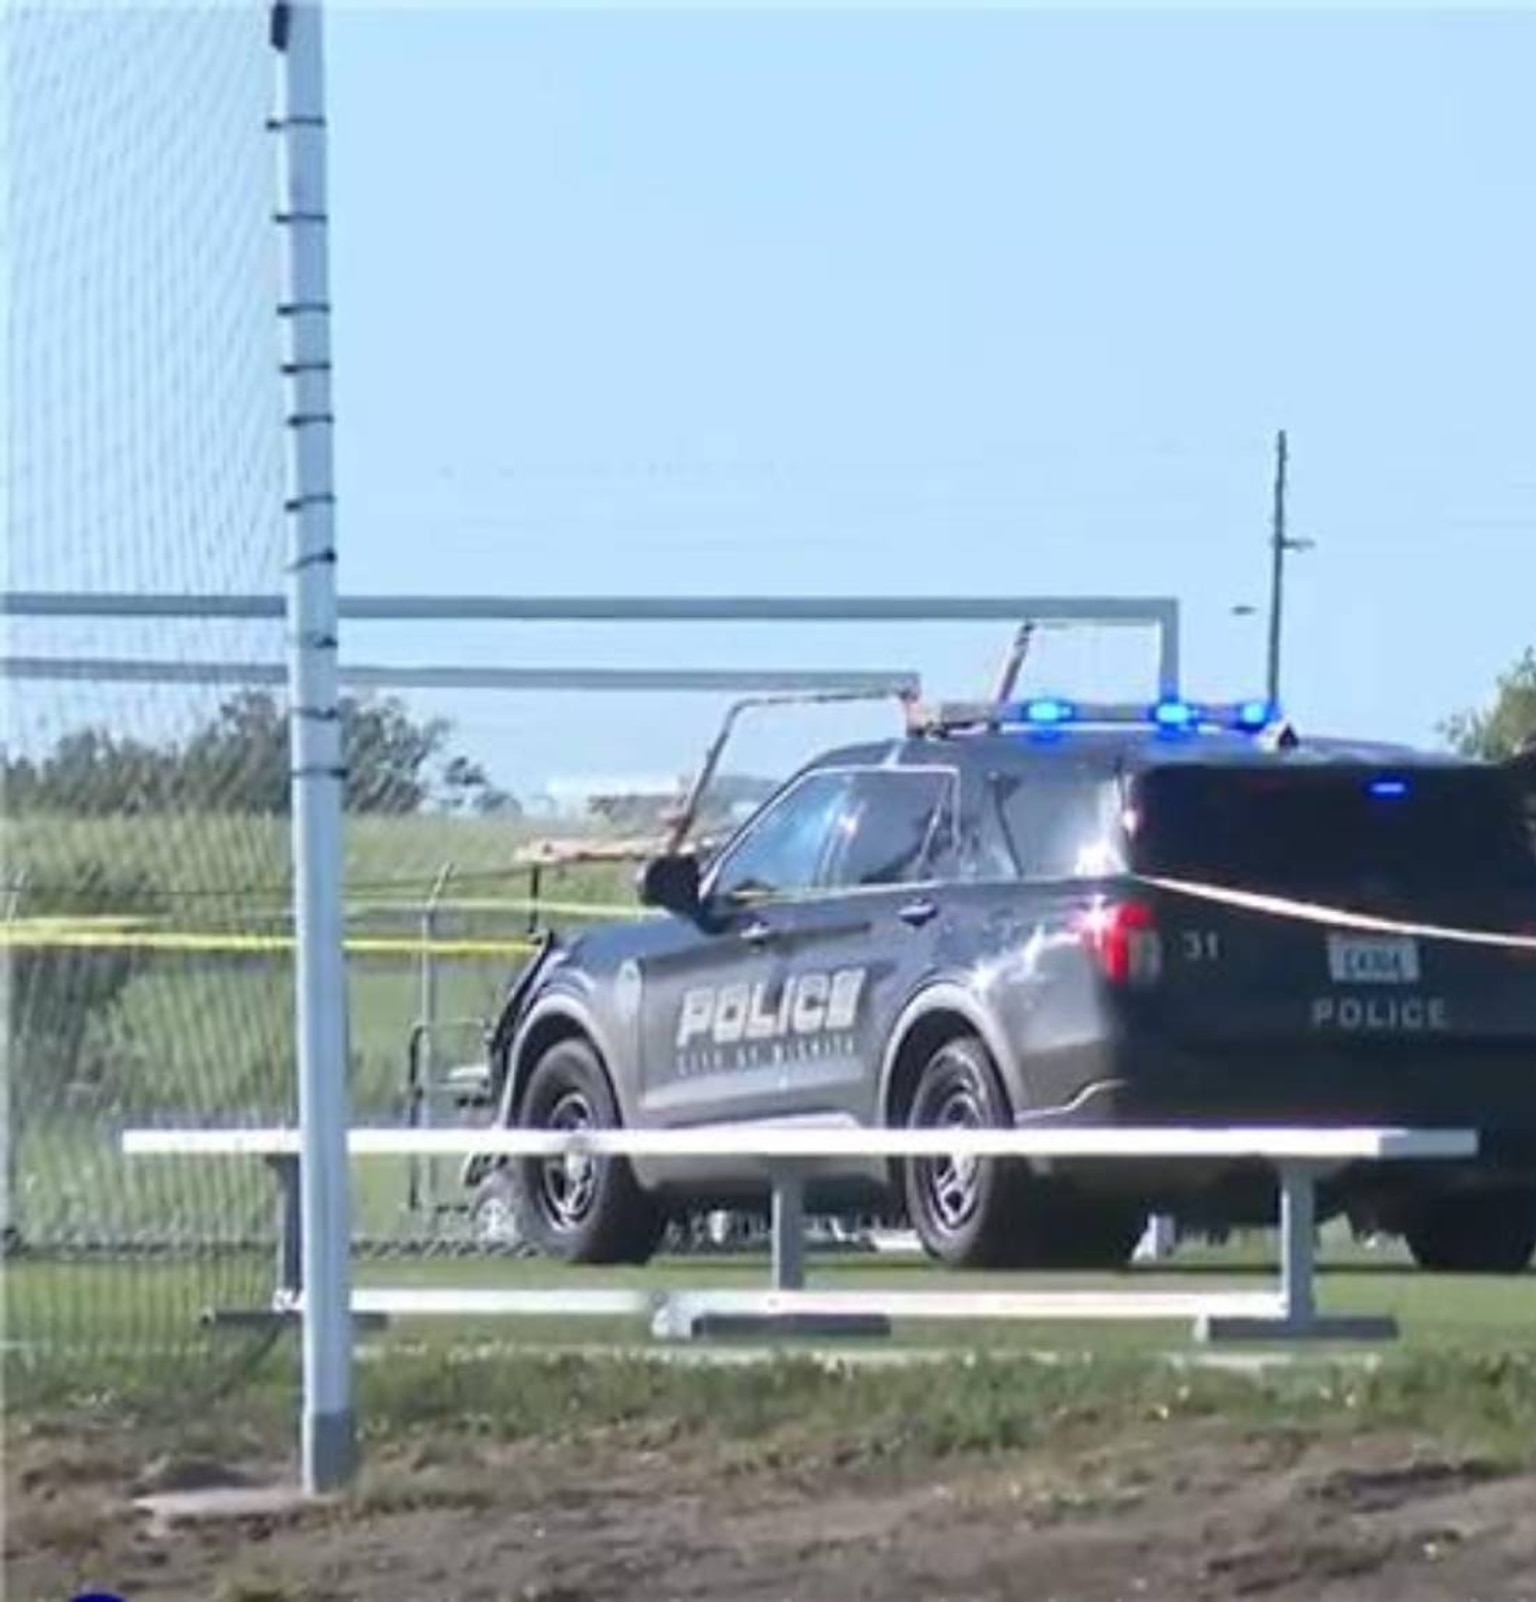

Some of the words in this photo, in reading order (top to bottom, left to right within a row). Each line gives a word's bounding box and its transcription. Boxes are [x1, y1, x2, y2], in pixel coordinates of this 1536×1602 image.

[1183, 930, 1219, 960] 31
[676, 966, 867, 1047] POLICE
[1311, 998, 1447, 1029] POLICE
